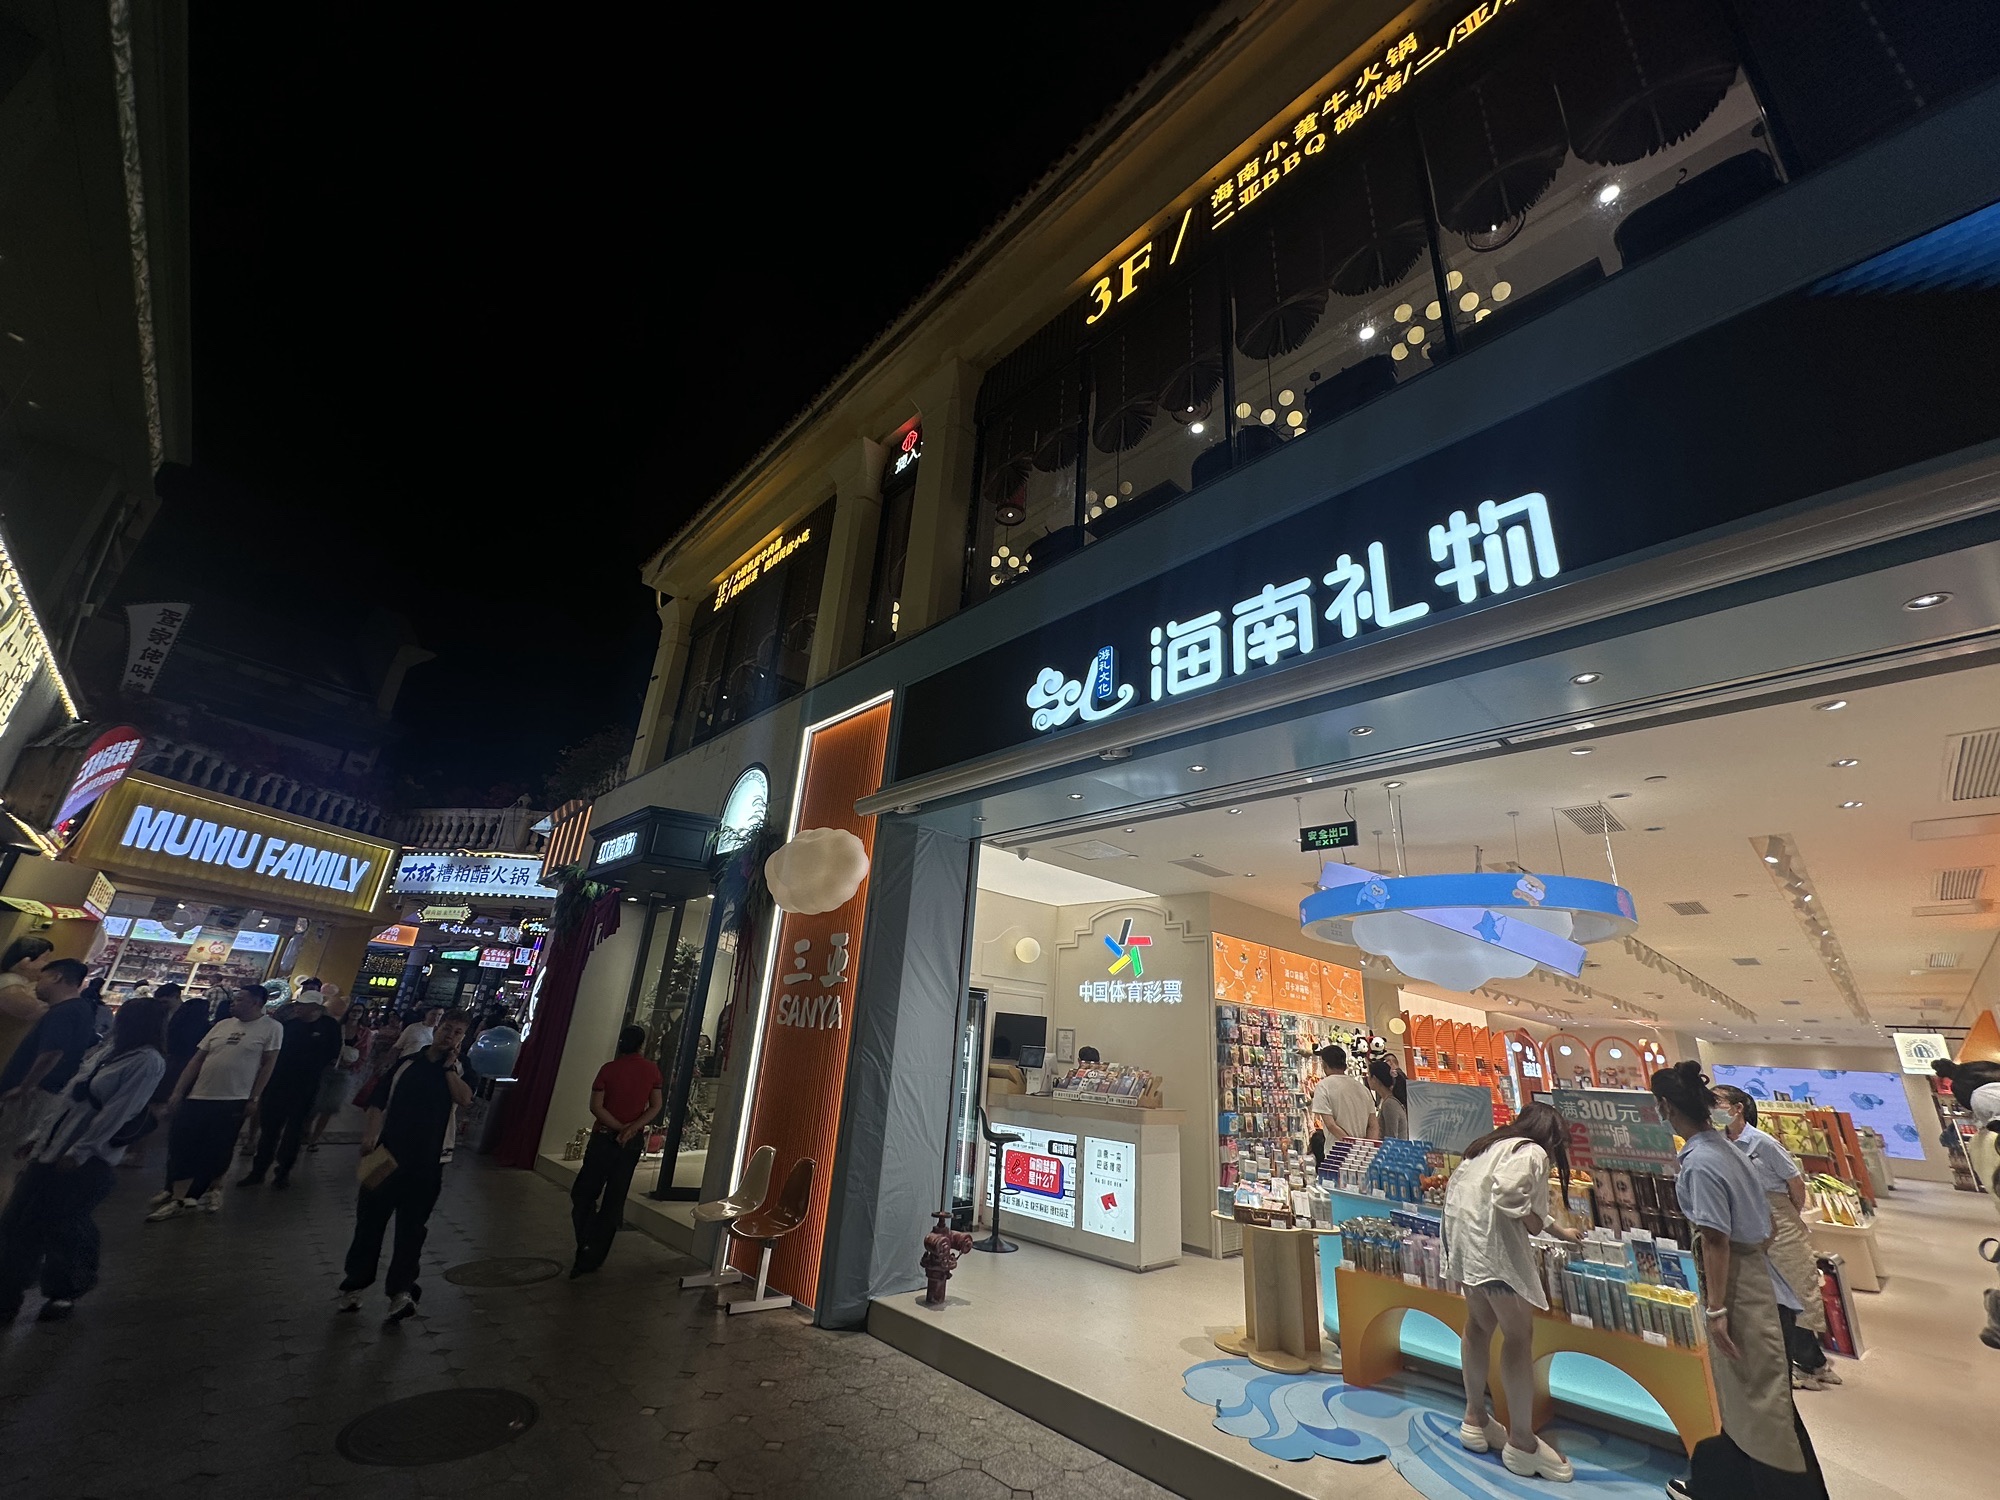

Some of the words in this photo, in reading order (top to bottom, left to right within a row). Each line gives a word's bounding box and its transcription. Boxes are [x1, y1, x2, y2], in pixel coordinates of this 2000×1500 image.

[1210, 31, 1418, 208] 海南小黄牛火锅
[1150, 491, 1561, 702] 海南礼物
[1098, 649, 1111, 695] 游礼文化
[121, 805, 262, 869] MUMU
[255, 837, 371, 893] FAMILY
[1307, 826, 1349, 841] 安全出口
[1315, 837, 1341, 847] EXIT
[782, 932, 850, 988] 三亚
[777, 994, 842, 1031] SANYA
[1079, 980, 1183, 1005] 中国体育彩票
[1569, 1122, 1595, 1167] SALE
[1610, 1124, 1633, 1149] 减
[1028, 1156, 1057, 1175] 你的梦想
